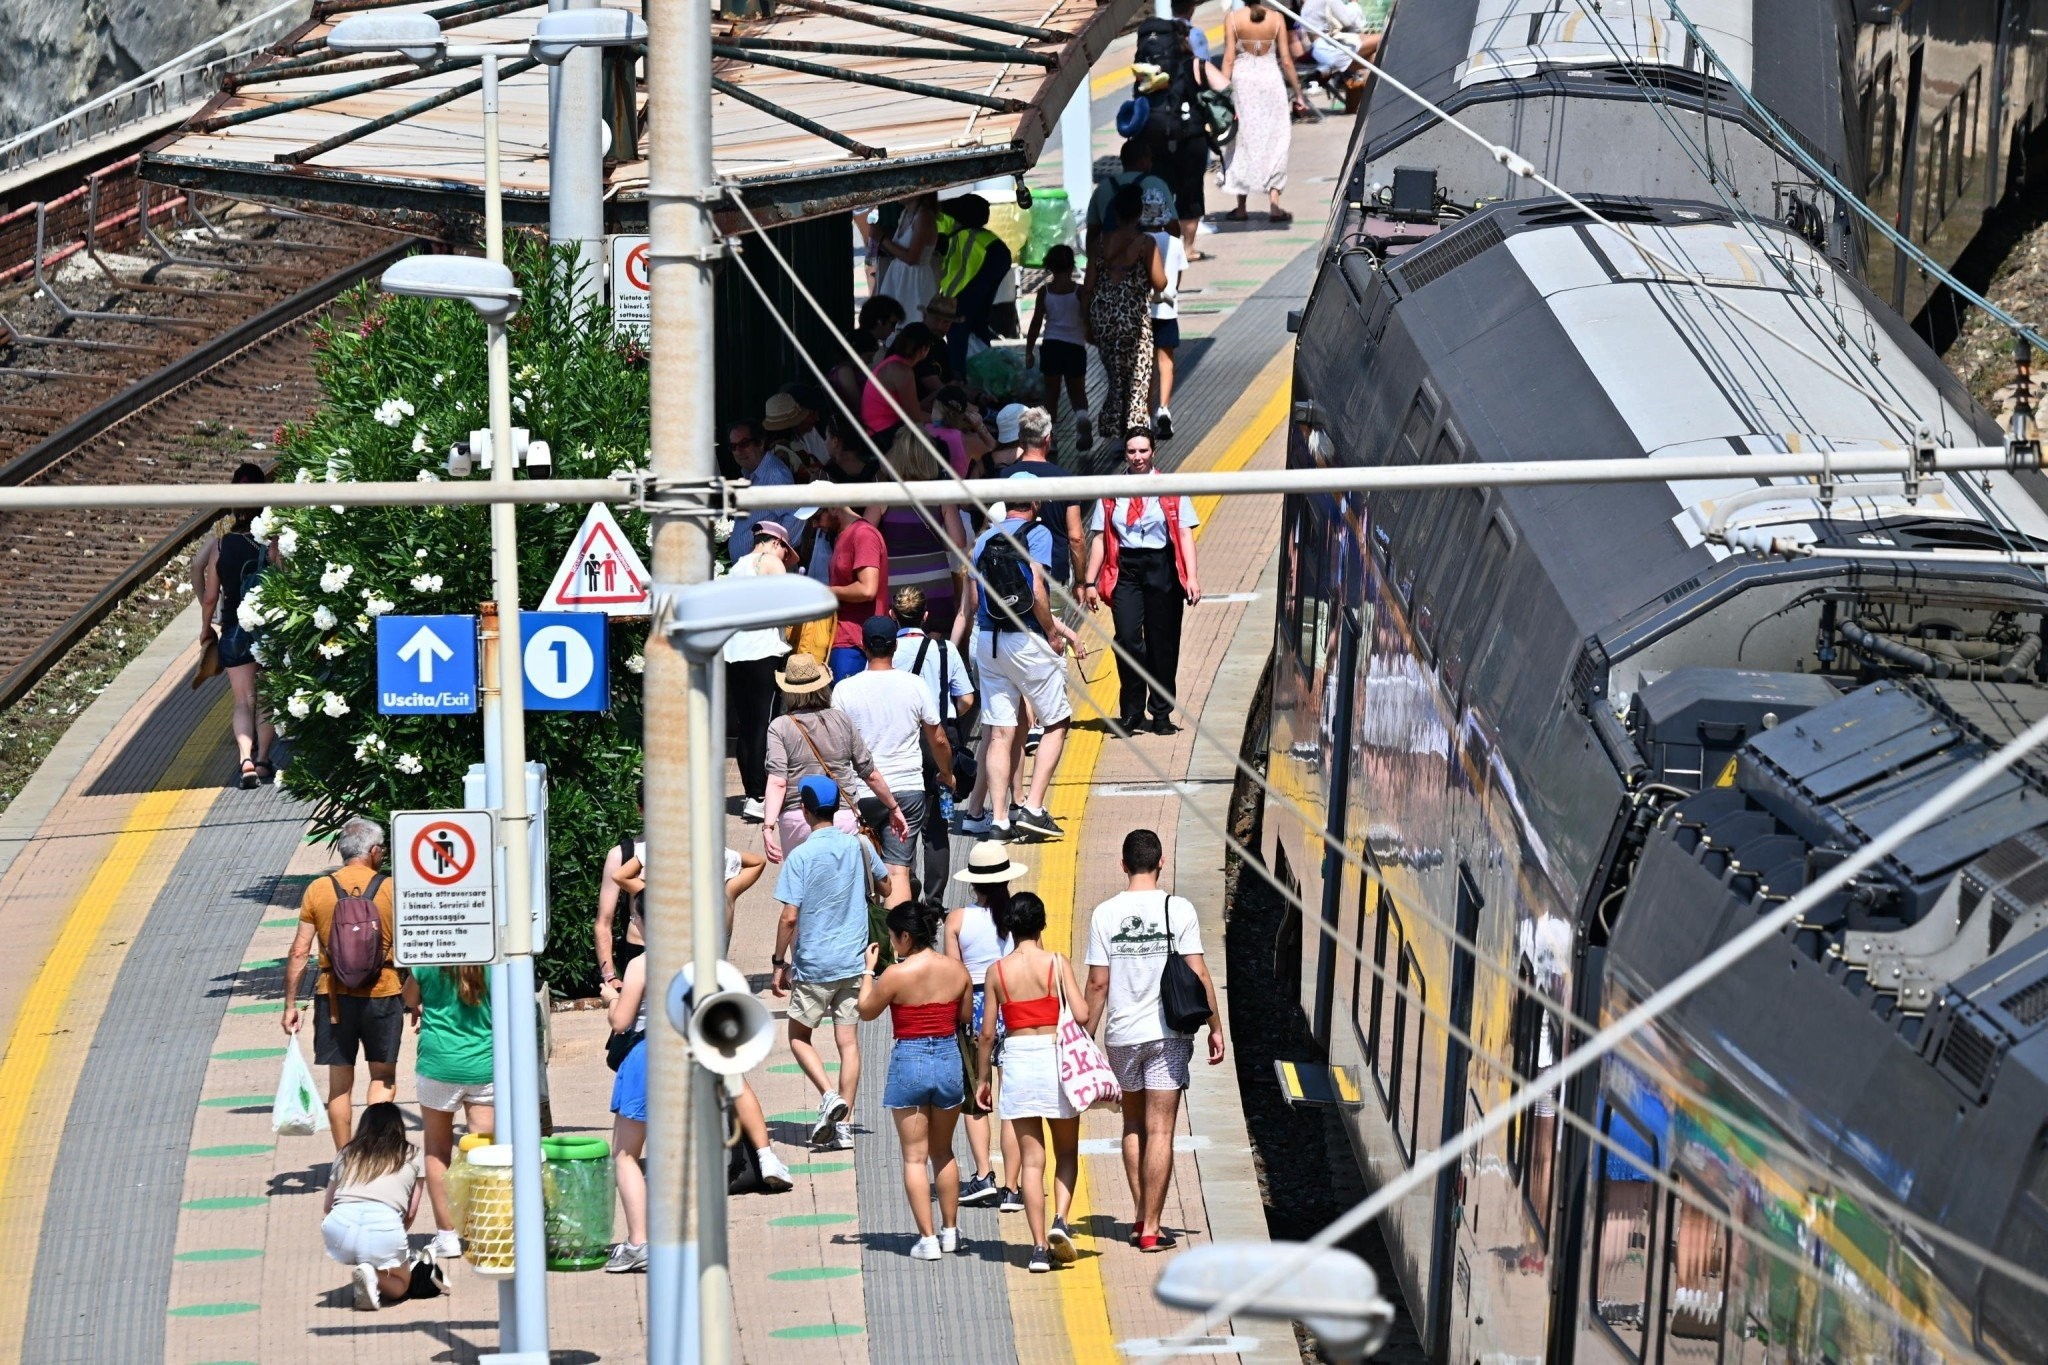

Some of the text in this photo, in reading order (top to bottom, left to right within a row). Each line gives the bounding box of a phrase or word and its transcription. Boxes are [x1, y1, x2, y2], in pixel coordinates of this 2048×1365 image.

[548, 640, 567, 684] 1
[383, 692, 470, 708] Uscita/Exit
[402, 890, 433, 898] Vietato
[408, 901, 436, 910] binari.
[438, 901, 470, 910] Servirsi
[471, 900, 485, 908] del
[403, 914, 466, 922] sottopassaggio
[402, 927, 468, 936] Do not cross the
[403, 939, 456, 948] railway lines
[403, 951, 466, 959] Use the subway
